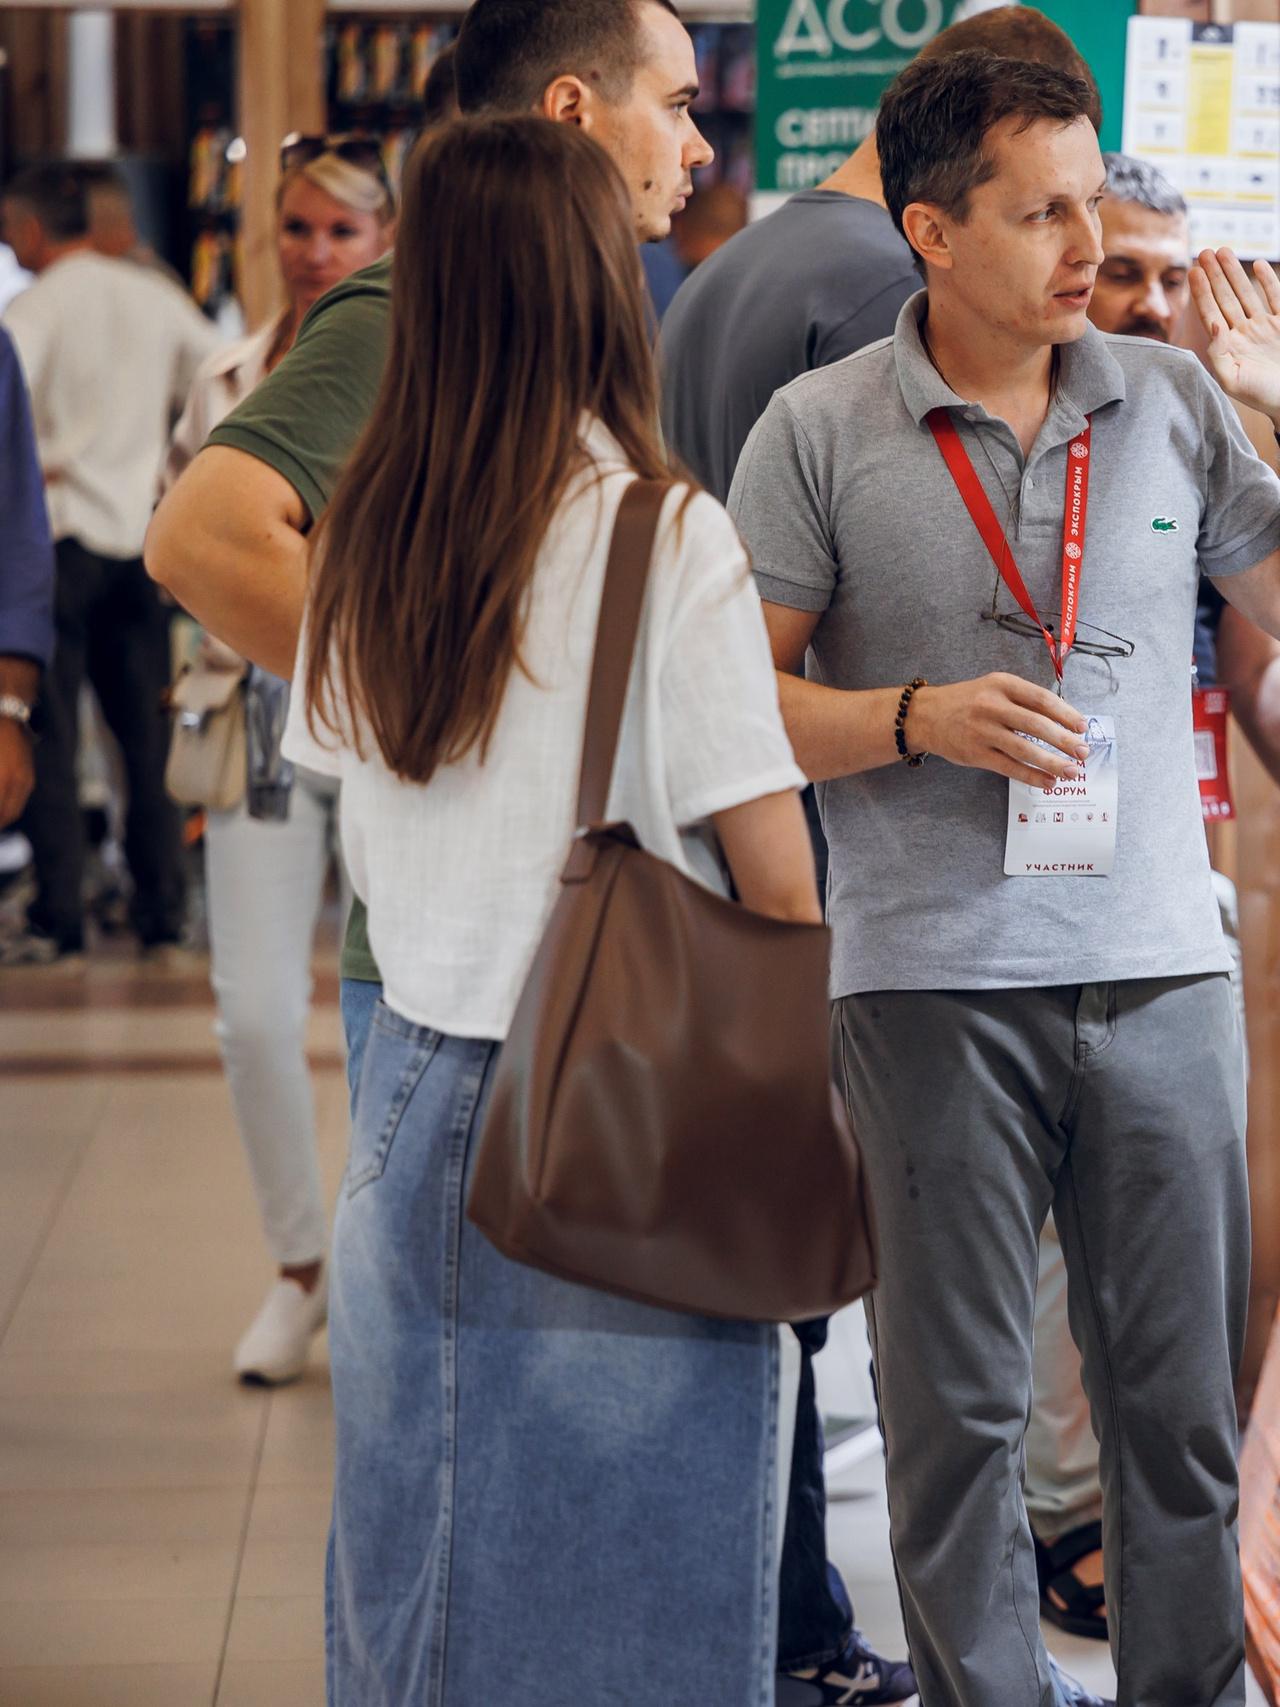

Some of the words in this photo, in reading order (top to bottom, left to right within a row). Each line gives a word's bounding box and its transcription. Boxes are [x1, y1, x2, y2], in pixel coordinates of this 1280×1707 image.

[1071, 466, 1083, 536] ЭКСПОКРЫМ
[1064, 565, 1076, 636] ЭКСПОКРЫМ
[1043, 786, 1087, 796] ФОРУМ
[1025, 863, 1095, 872] УЧАСТНИК
